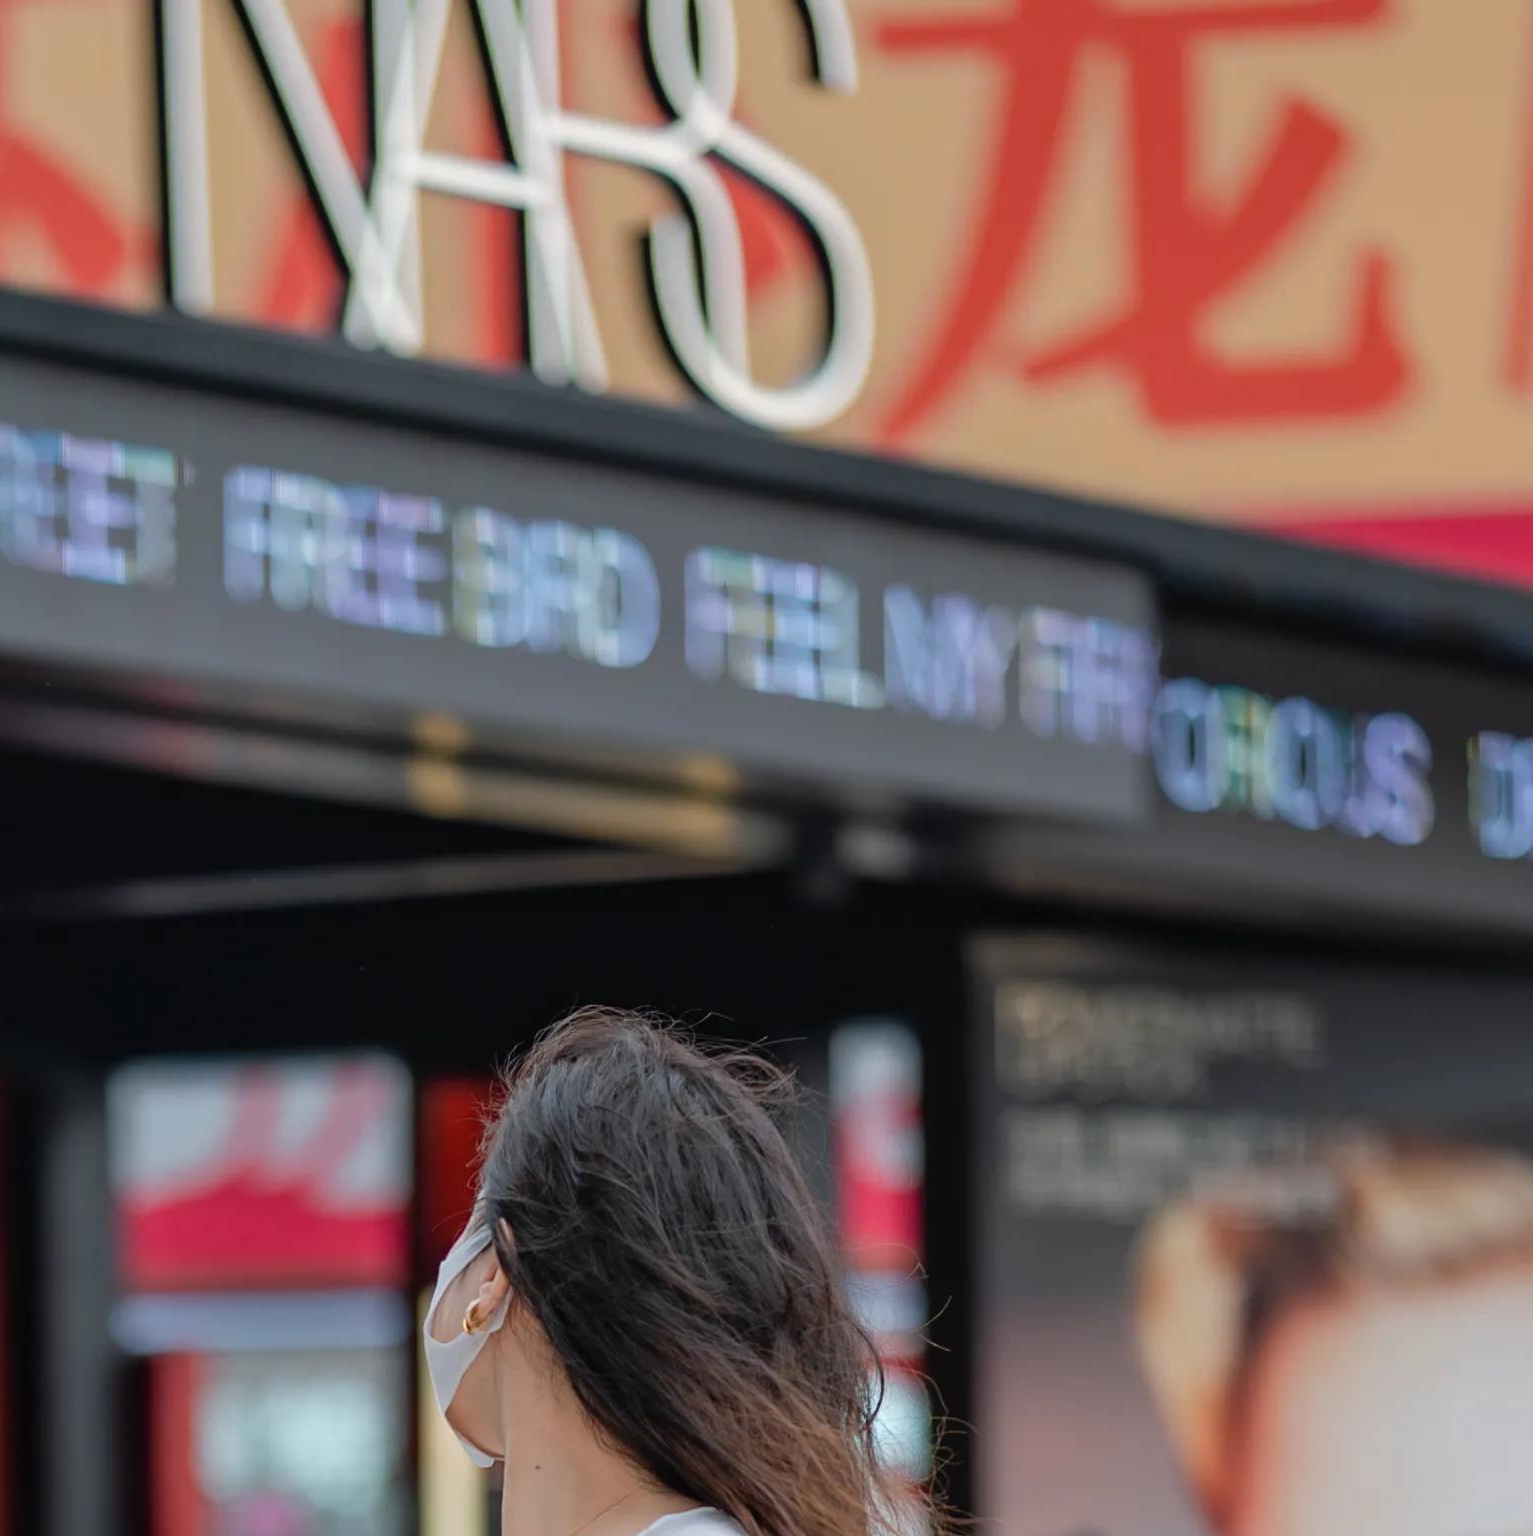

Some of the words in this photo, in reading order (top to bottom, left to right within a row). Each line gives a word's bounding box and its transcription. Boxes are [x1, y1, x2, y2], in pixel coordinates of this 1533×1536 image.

[161, 0, 873, 430] NARS
[223, 464, 446, 637] FREE
[680, 545, 886, 711] FEEL
